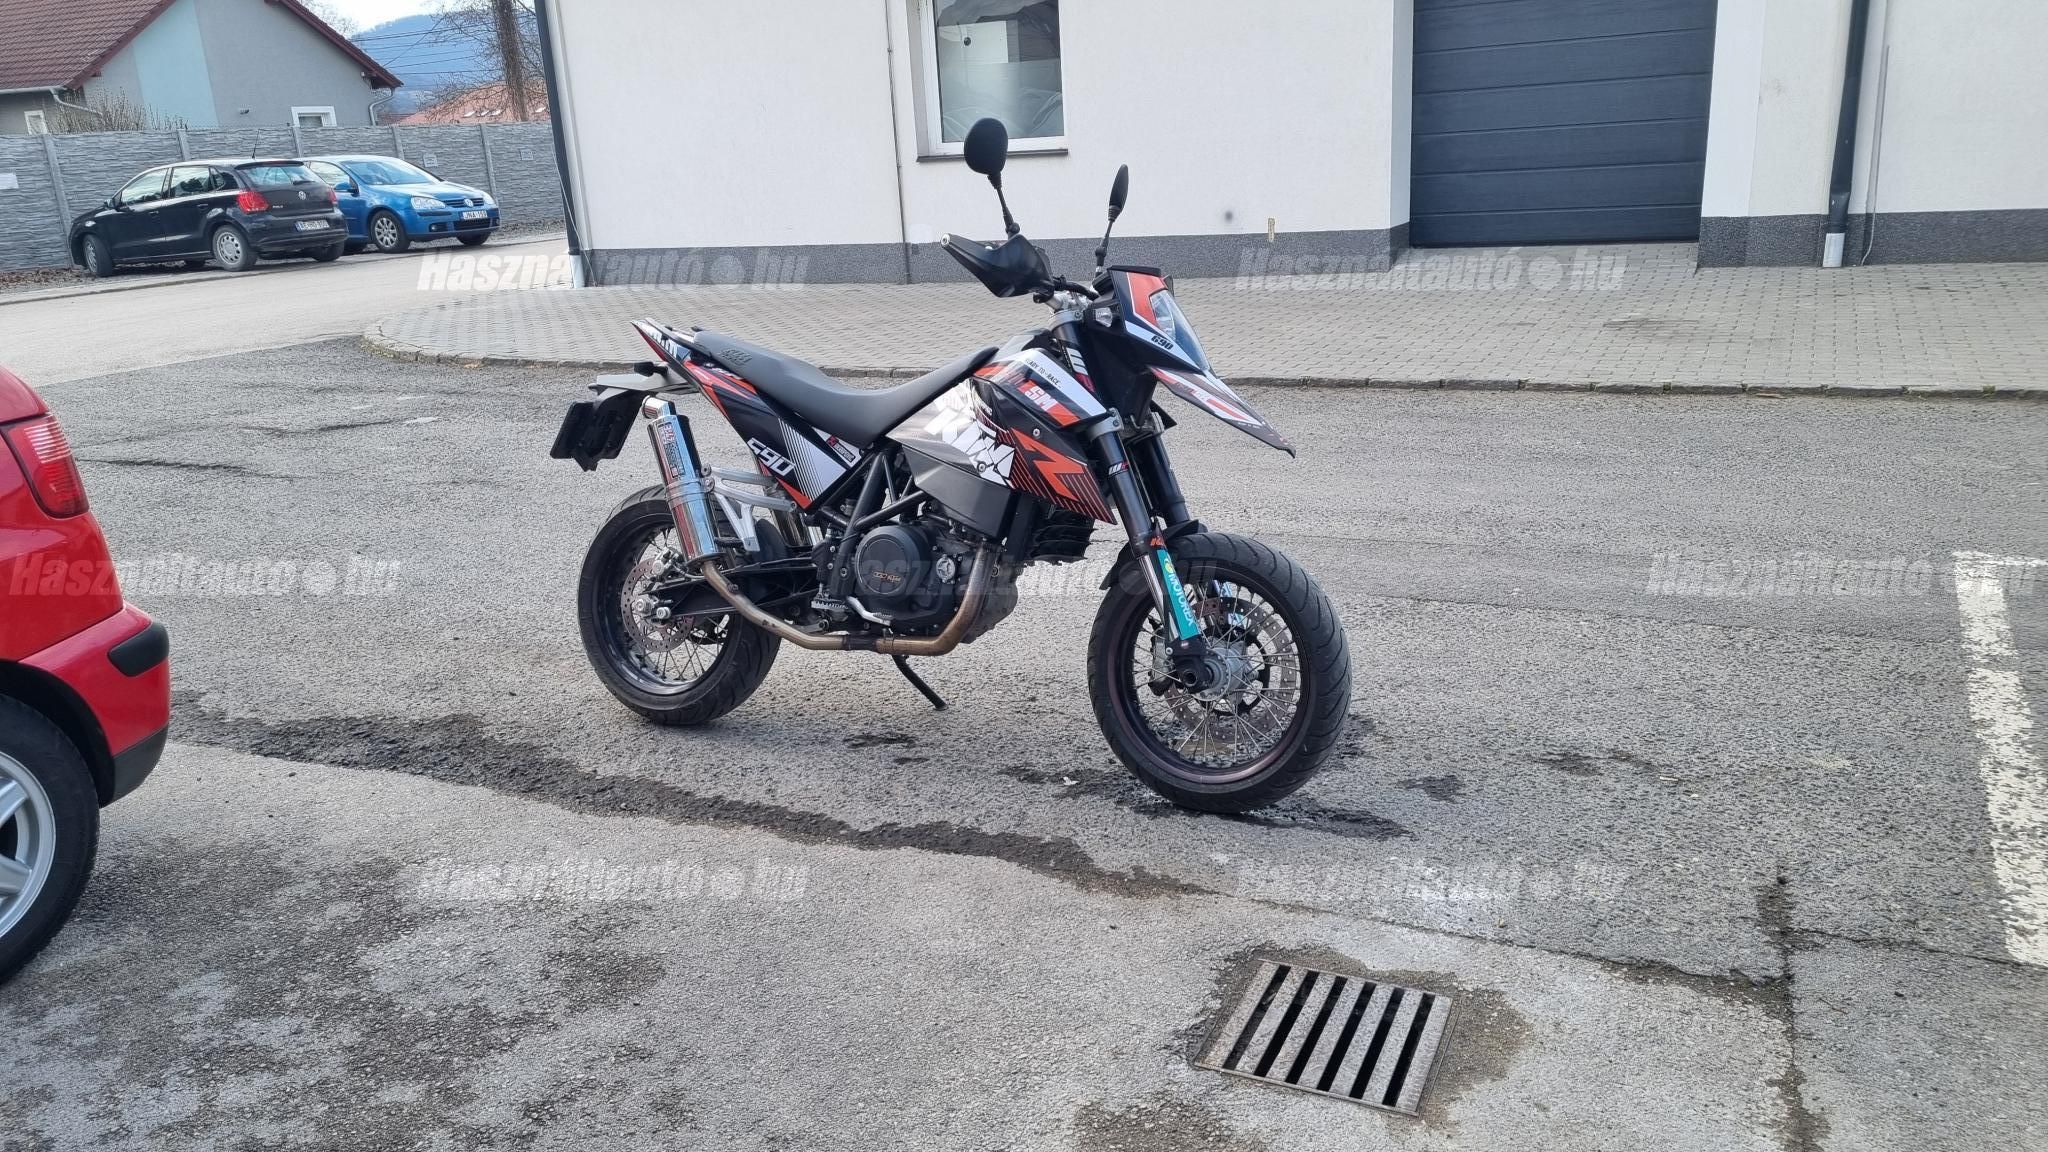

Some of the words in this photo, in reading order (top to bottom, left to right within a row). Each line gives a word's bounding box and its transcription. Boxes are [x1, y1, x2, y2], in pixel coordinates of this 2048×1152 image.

[1151, 335, 1174, 351] 690
[1024, 386, 1058, 412] SM
[1168, 573, 1194, 627] MOTOREX
